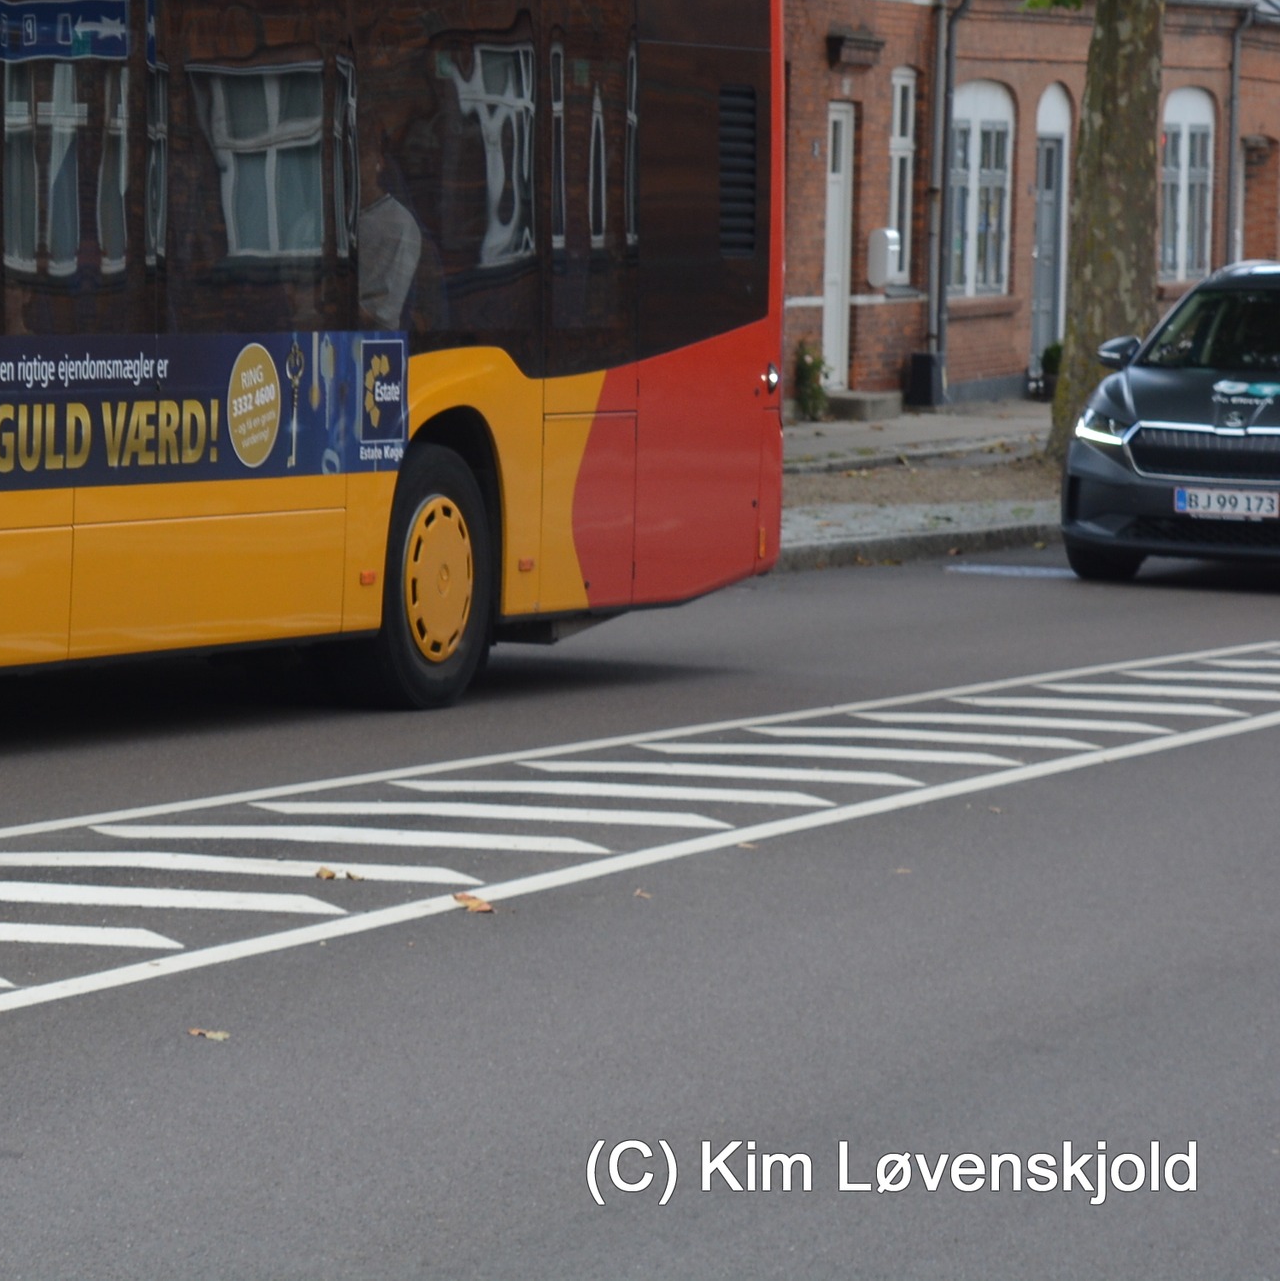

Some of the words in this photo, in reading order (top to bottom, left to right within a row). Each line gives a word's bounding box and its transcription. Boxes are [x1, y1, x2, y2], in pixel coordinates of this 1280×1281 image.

[18, 355, 55, 388] rigtige
[58, 352, 155, 387] ejendomsmægler
[157, 359, 169, 378] er
[241, 365, 263, 389] RING
[374, 380, 400, 402] Estate
[232, 393, 253, 417] 3332
[101, 399, 219, 467] VÆRD!
[359, 446, 381, 461] Estate
[1217, 494, 1238, 510] 99
[1245, 496, 1275, 513] 173
